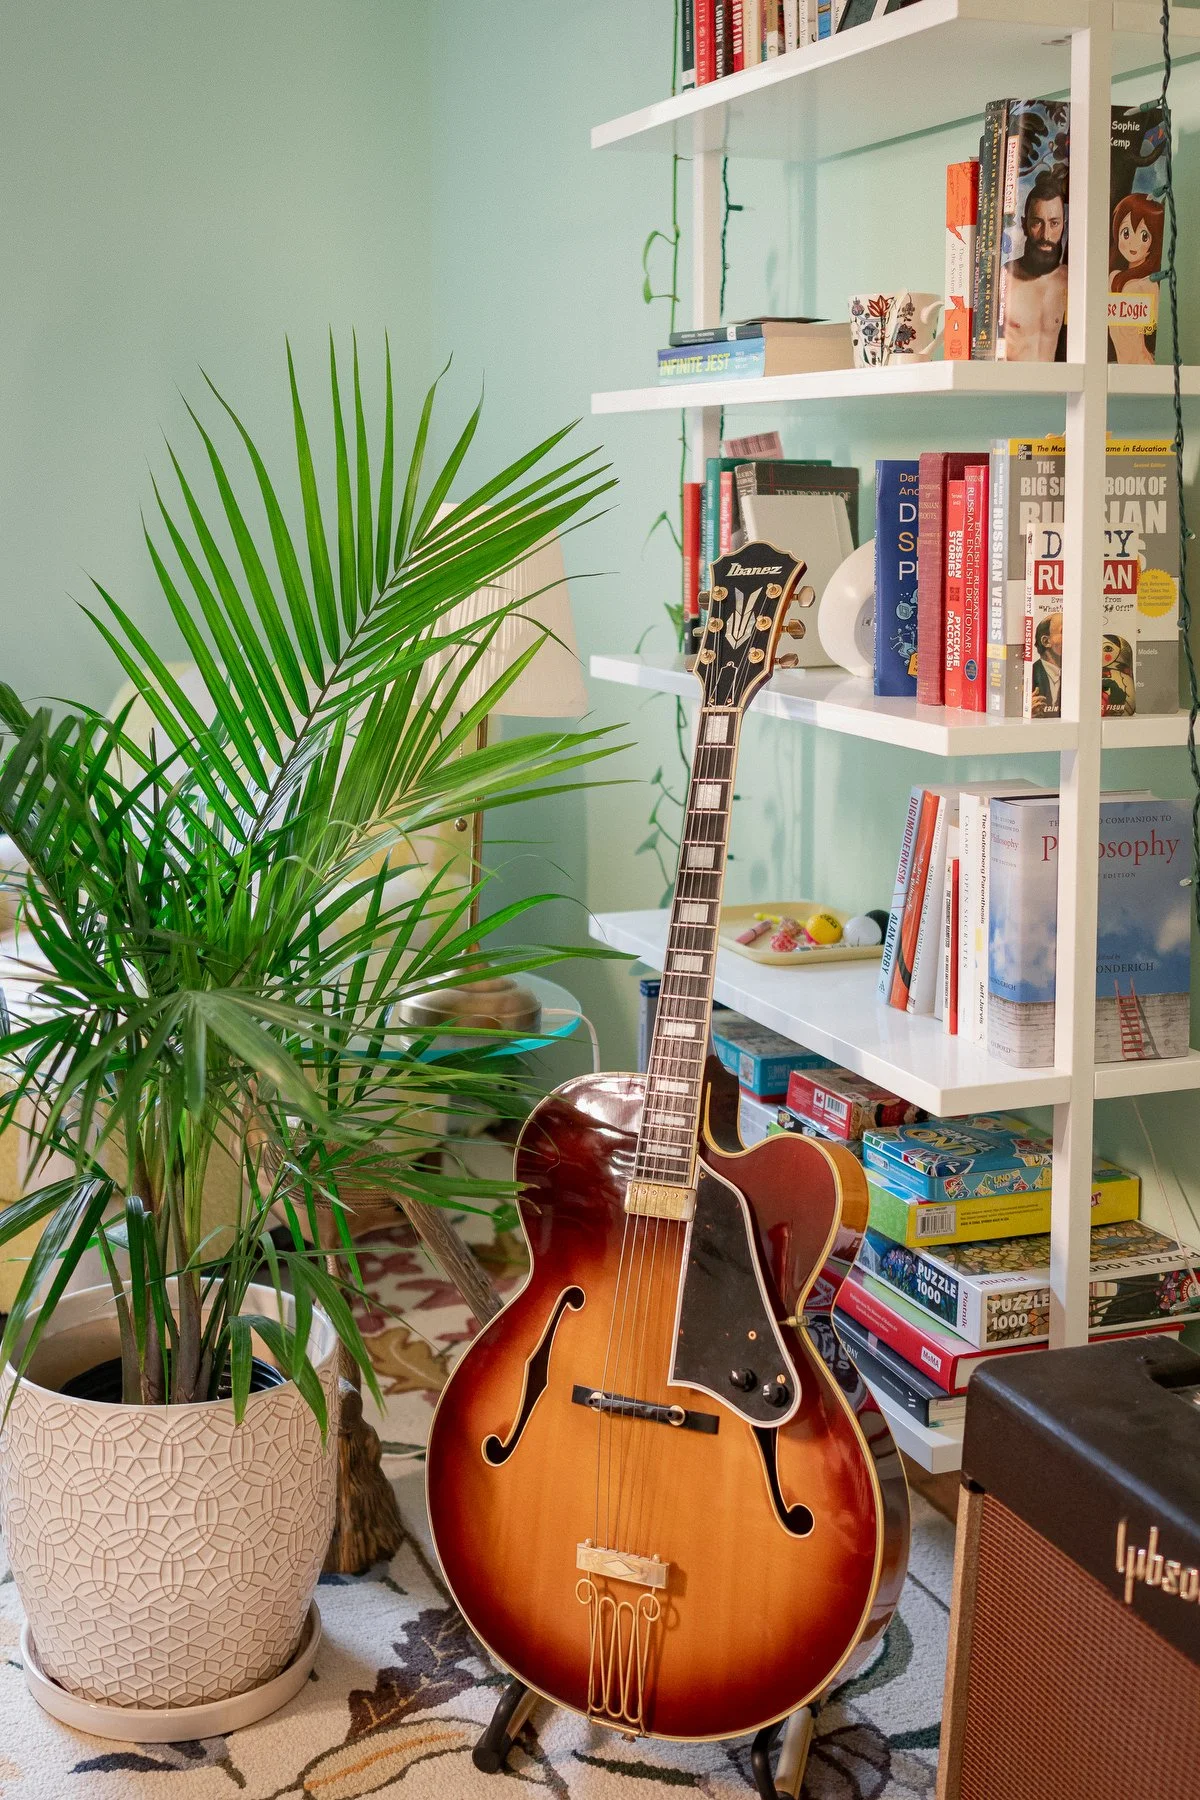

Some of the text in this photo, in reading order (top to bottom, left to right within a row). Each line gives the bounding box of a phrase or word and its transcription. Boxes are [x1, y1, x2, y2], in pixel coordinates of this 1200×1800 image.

[698, 61, 706, 86] BEA
[1111, 120, 1140, 133] Sophie
[1119, 301, 1148, 320] Logic
[659, 355, 704, 377] INFINITE
[704, 352, 731, 374] JEST
[1036, 444, 1049, 453] The
[1051, 445, 1066, 453] Mos
[1123, 445, 1130, 453] in
[1132, 445, 1167, 453] Education
[1036, 461, 1056, 474] THE
[1020, 476, 1048, 497] BIG
[1104, 476, 1147, 496] BOOK
[1148, 476, 1167, 496] OF
[947, 531, 956, 577] STORIES
[955, 530, 963, 578] RUSSIAN
[991, 507, 1004, 582] RUSSIAN
[725, 562, 784, 577] Ibanez
[964, 588, 973, 655] DICTIONARY
[990, 586, 1003, 641] VERBS
[946, 610, 954, 671] РАССКАЗЫ
[953, 616, 961, 667] РУССКИЕ
[1105, 815, 1159, 824] COMPANION
[1160, 814, 1172, 822] TO
[881, 796, 919, 975] DIGIMODERNISM ALAN KIRBY
[922, 865, 934, 915] SIMULACRA
[979, 875, 987, 924] Parenthesis
[912, 929, 924, 984] SIMULATION
[1096, 963, 1154, 975] ONDERICH
[904, 1129, 984, 1157] UNO
[916, 1261, 957, 1299] PUZZLE
[916, 1279, 942, 1305] 1000
[978, 1276, 1029, 1287] Platnik
[991, 1294, 1050, 1313] PUZZLE
[991, 1313, 1029, 1331] 1000
[847, 1346, 859, 1359] DAY
[922, 1350, 940, 1368] MoMA
[1115, 1516, 1200, 1605] Gibso
